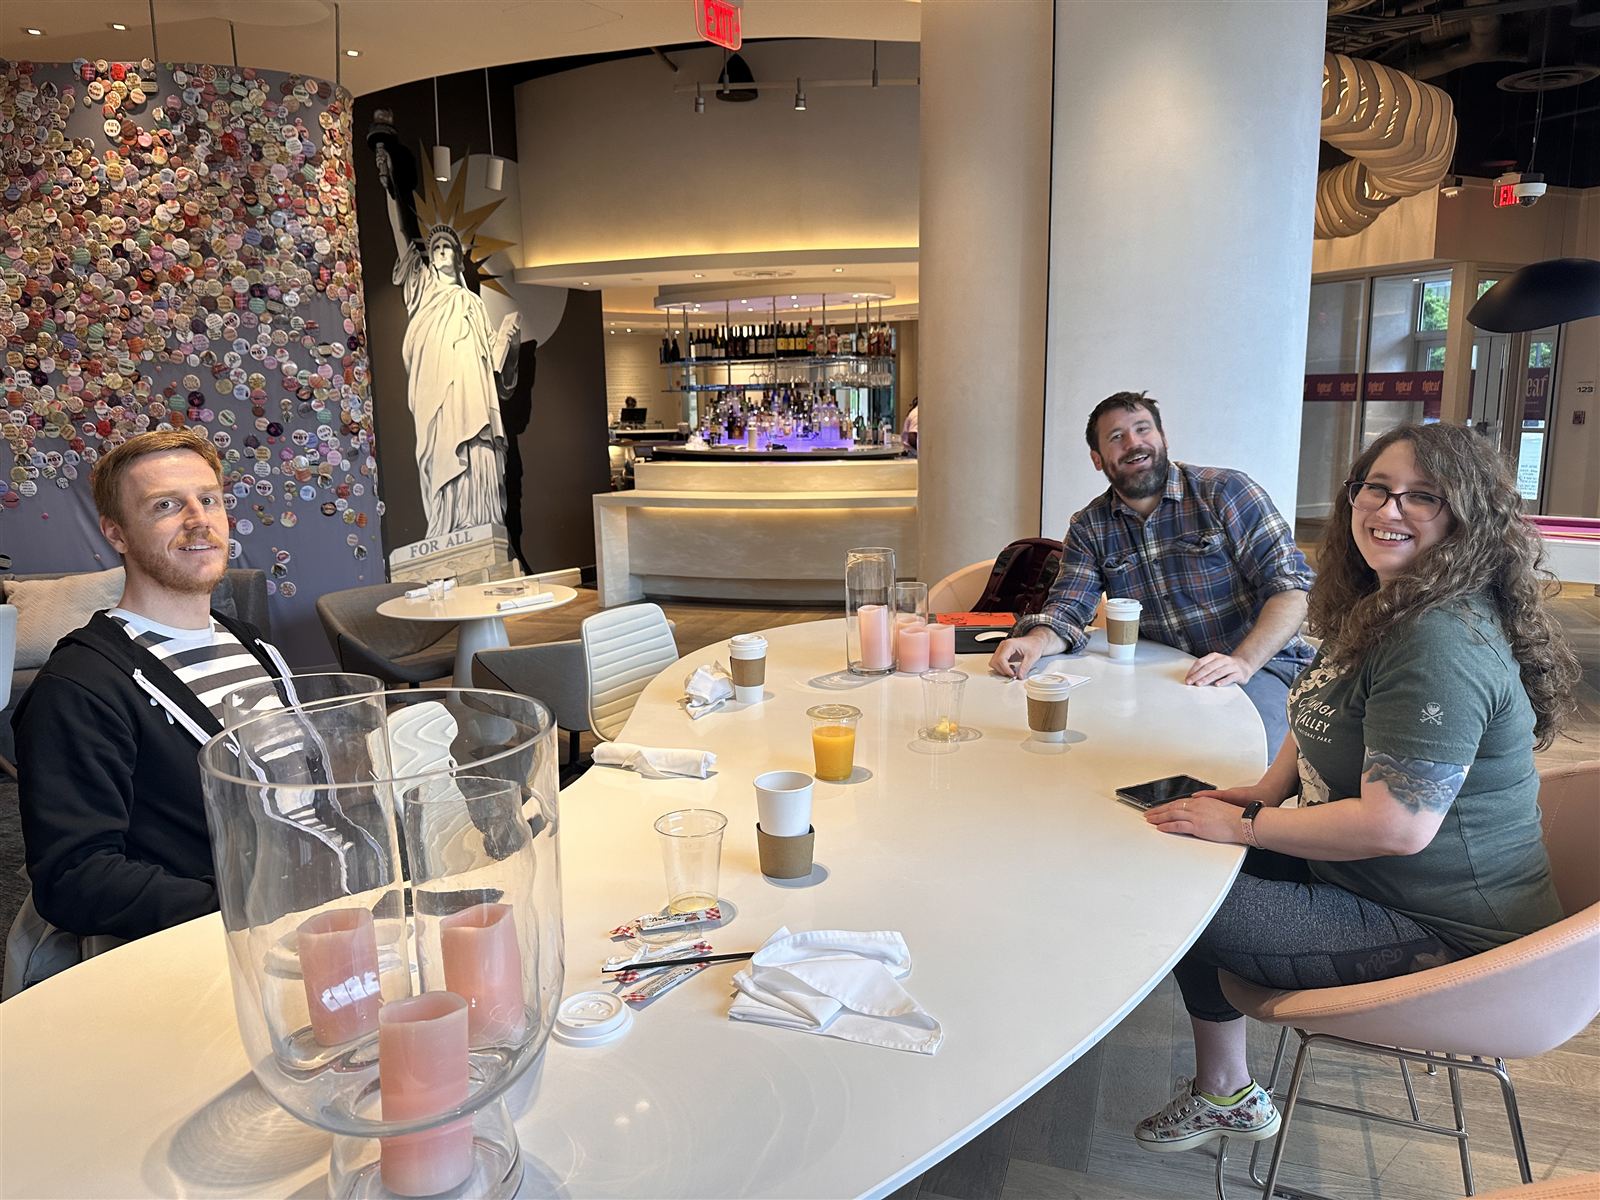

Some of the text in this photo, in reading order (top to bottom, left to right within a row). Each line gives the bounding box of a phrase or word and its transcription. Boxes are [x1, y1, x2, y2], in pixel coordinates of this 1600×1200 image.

[704, 0, 734, 45] EXIT
[410, 531, 473, 558] FOR ALL
[1295, 707, 1331, 733] VALLEY
[1297, 727, 1333, 744] NATIONAL PARK
